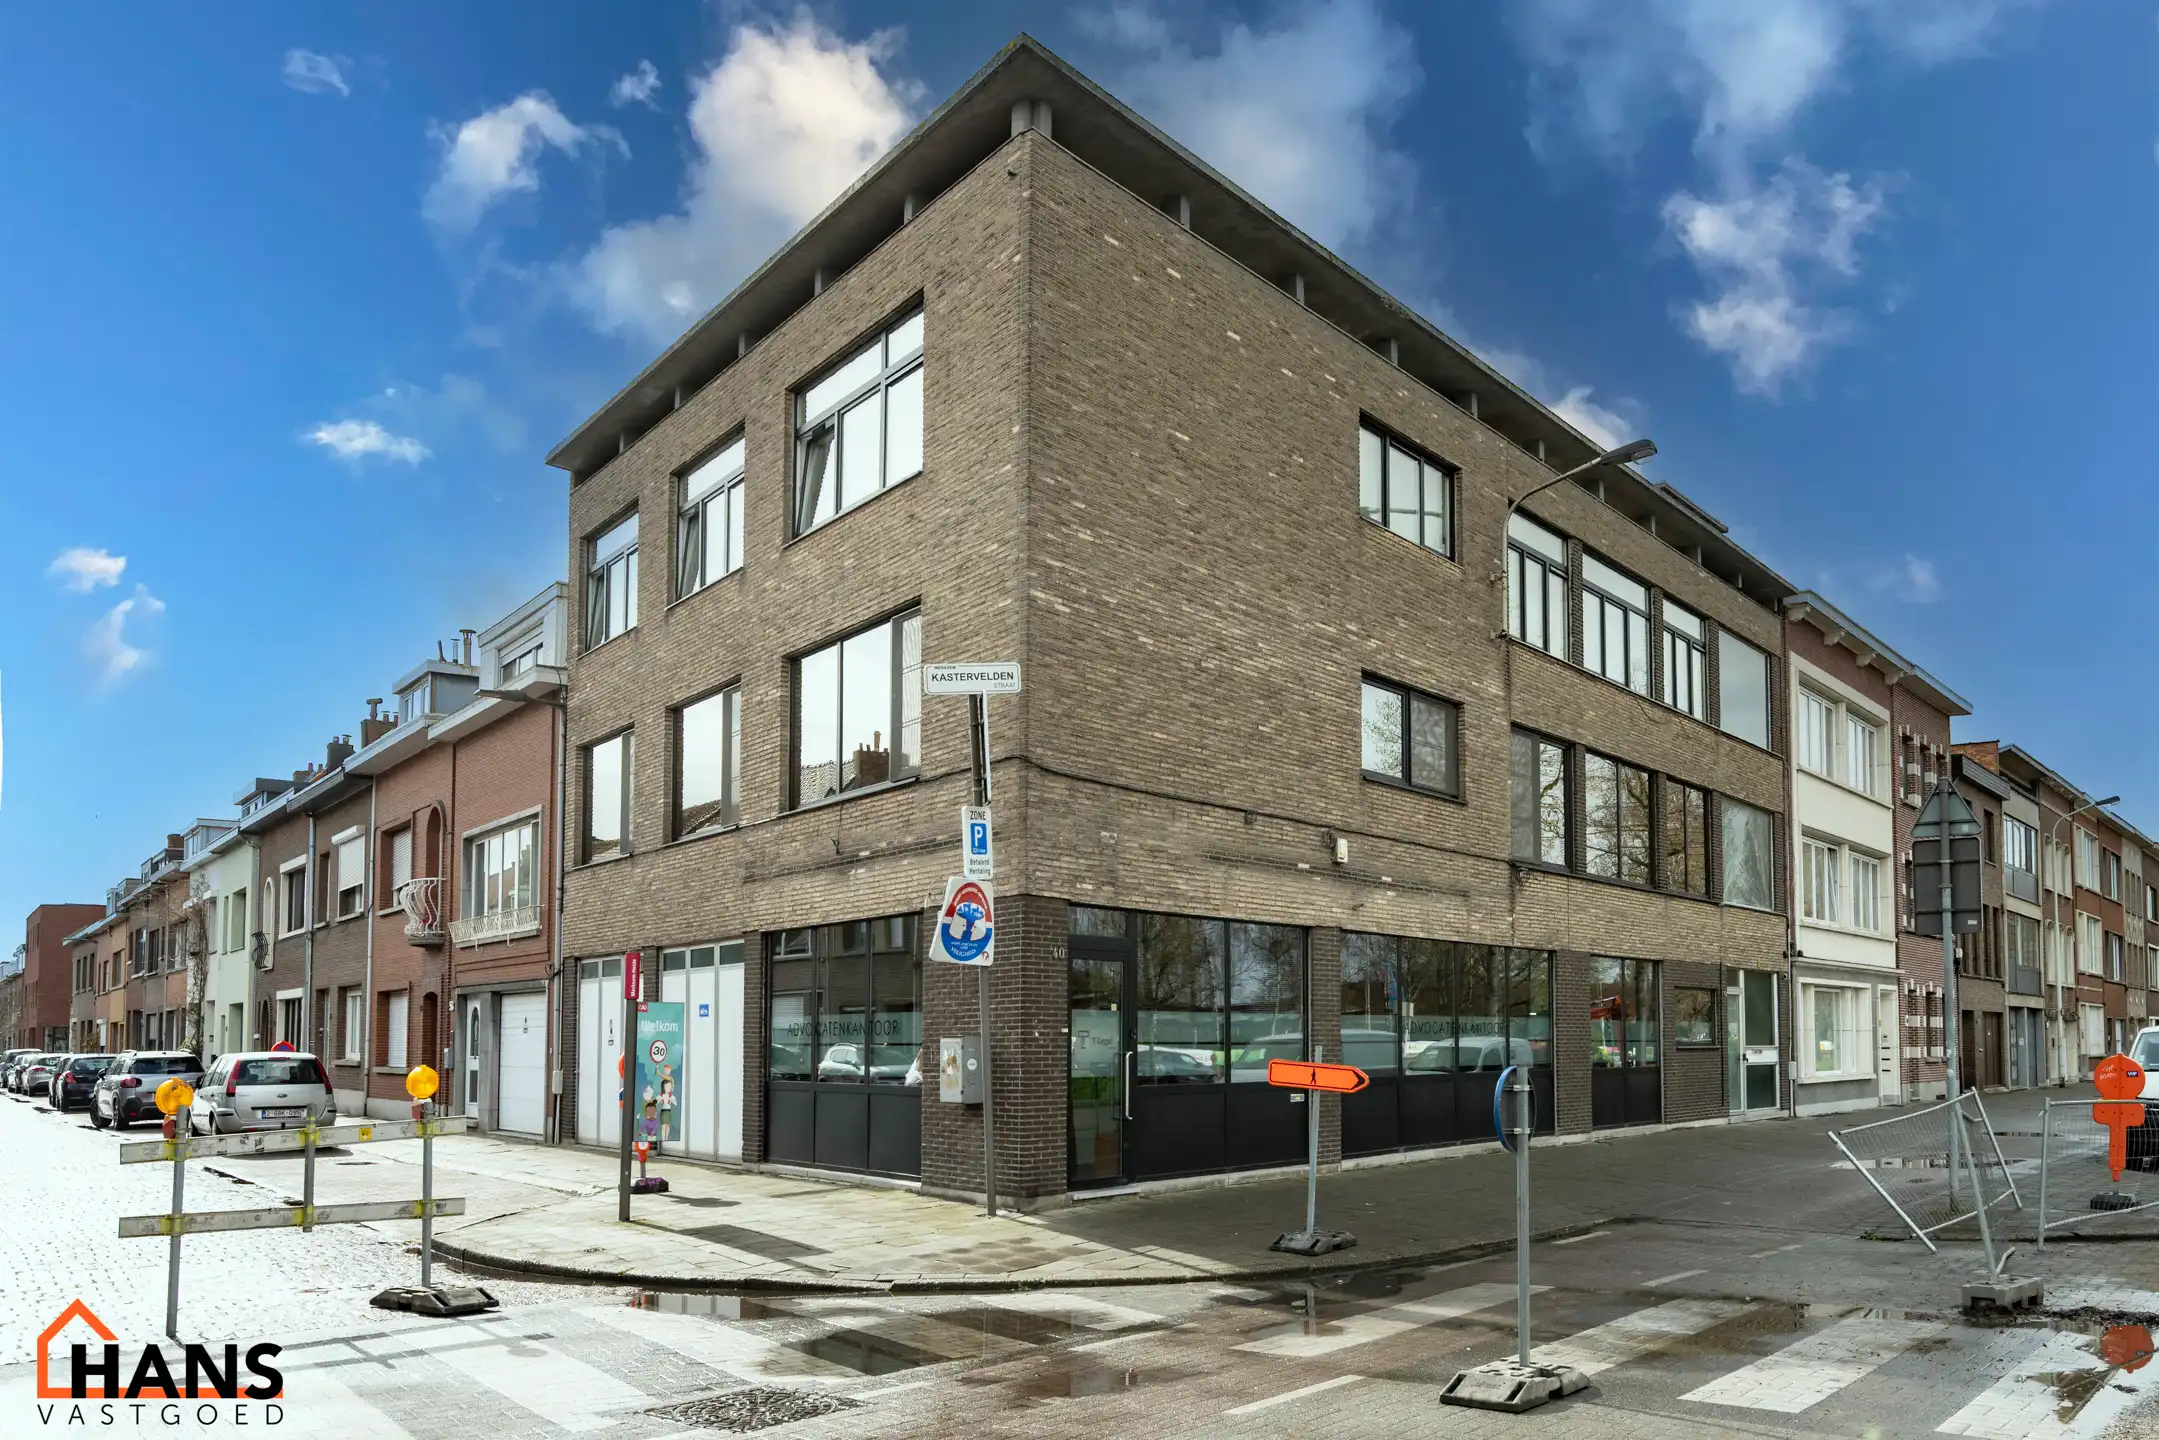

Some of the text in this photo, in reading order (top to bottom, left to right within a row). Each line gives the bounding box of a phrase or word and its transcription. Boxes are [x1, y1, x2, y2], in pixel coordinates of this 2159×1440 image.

[931, 671, 1014, 682] KASTERVELDEN
[969, 810, 986, 821] ZONE
[974, 825, 983, 847] P
[1051, 947, 1065, 959] 40
[641, 1020, 679, 1032] Welkom
[653, 1045, 665, 1057] 30
